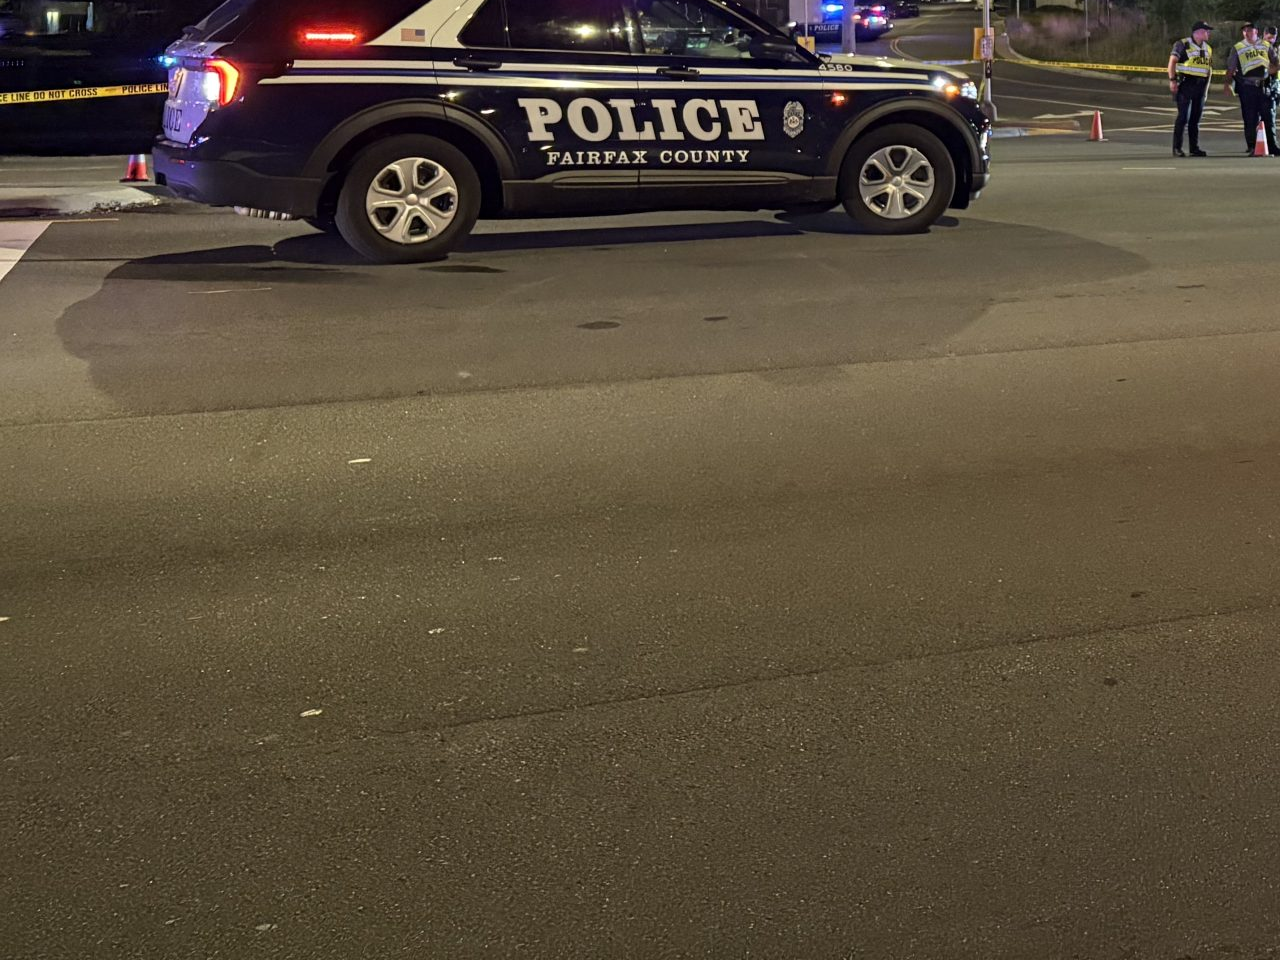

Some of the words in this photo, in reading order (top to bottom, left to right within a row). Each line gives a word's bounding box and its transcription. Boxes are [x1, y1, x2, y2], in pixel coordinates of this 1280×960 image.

[814, 24, 840, 32] POLICE
[818, 62, 853, 72] 4580
[121, 83, 153, 94] POLICE
[155, 82, 168, 92] LIN
[11, 92, 31, 102] LINE
[33, 91, 46, 100] DO
[48, 90, 65, 99] NOT
[69, 88, 98, 98] CROSS
[517, 97, 765, 142] POLICE
[547, 150, 648, 166] FAIRFAX
[659, 149, 750, 164] COUNTY
